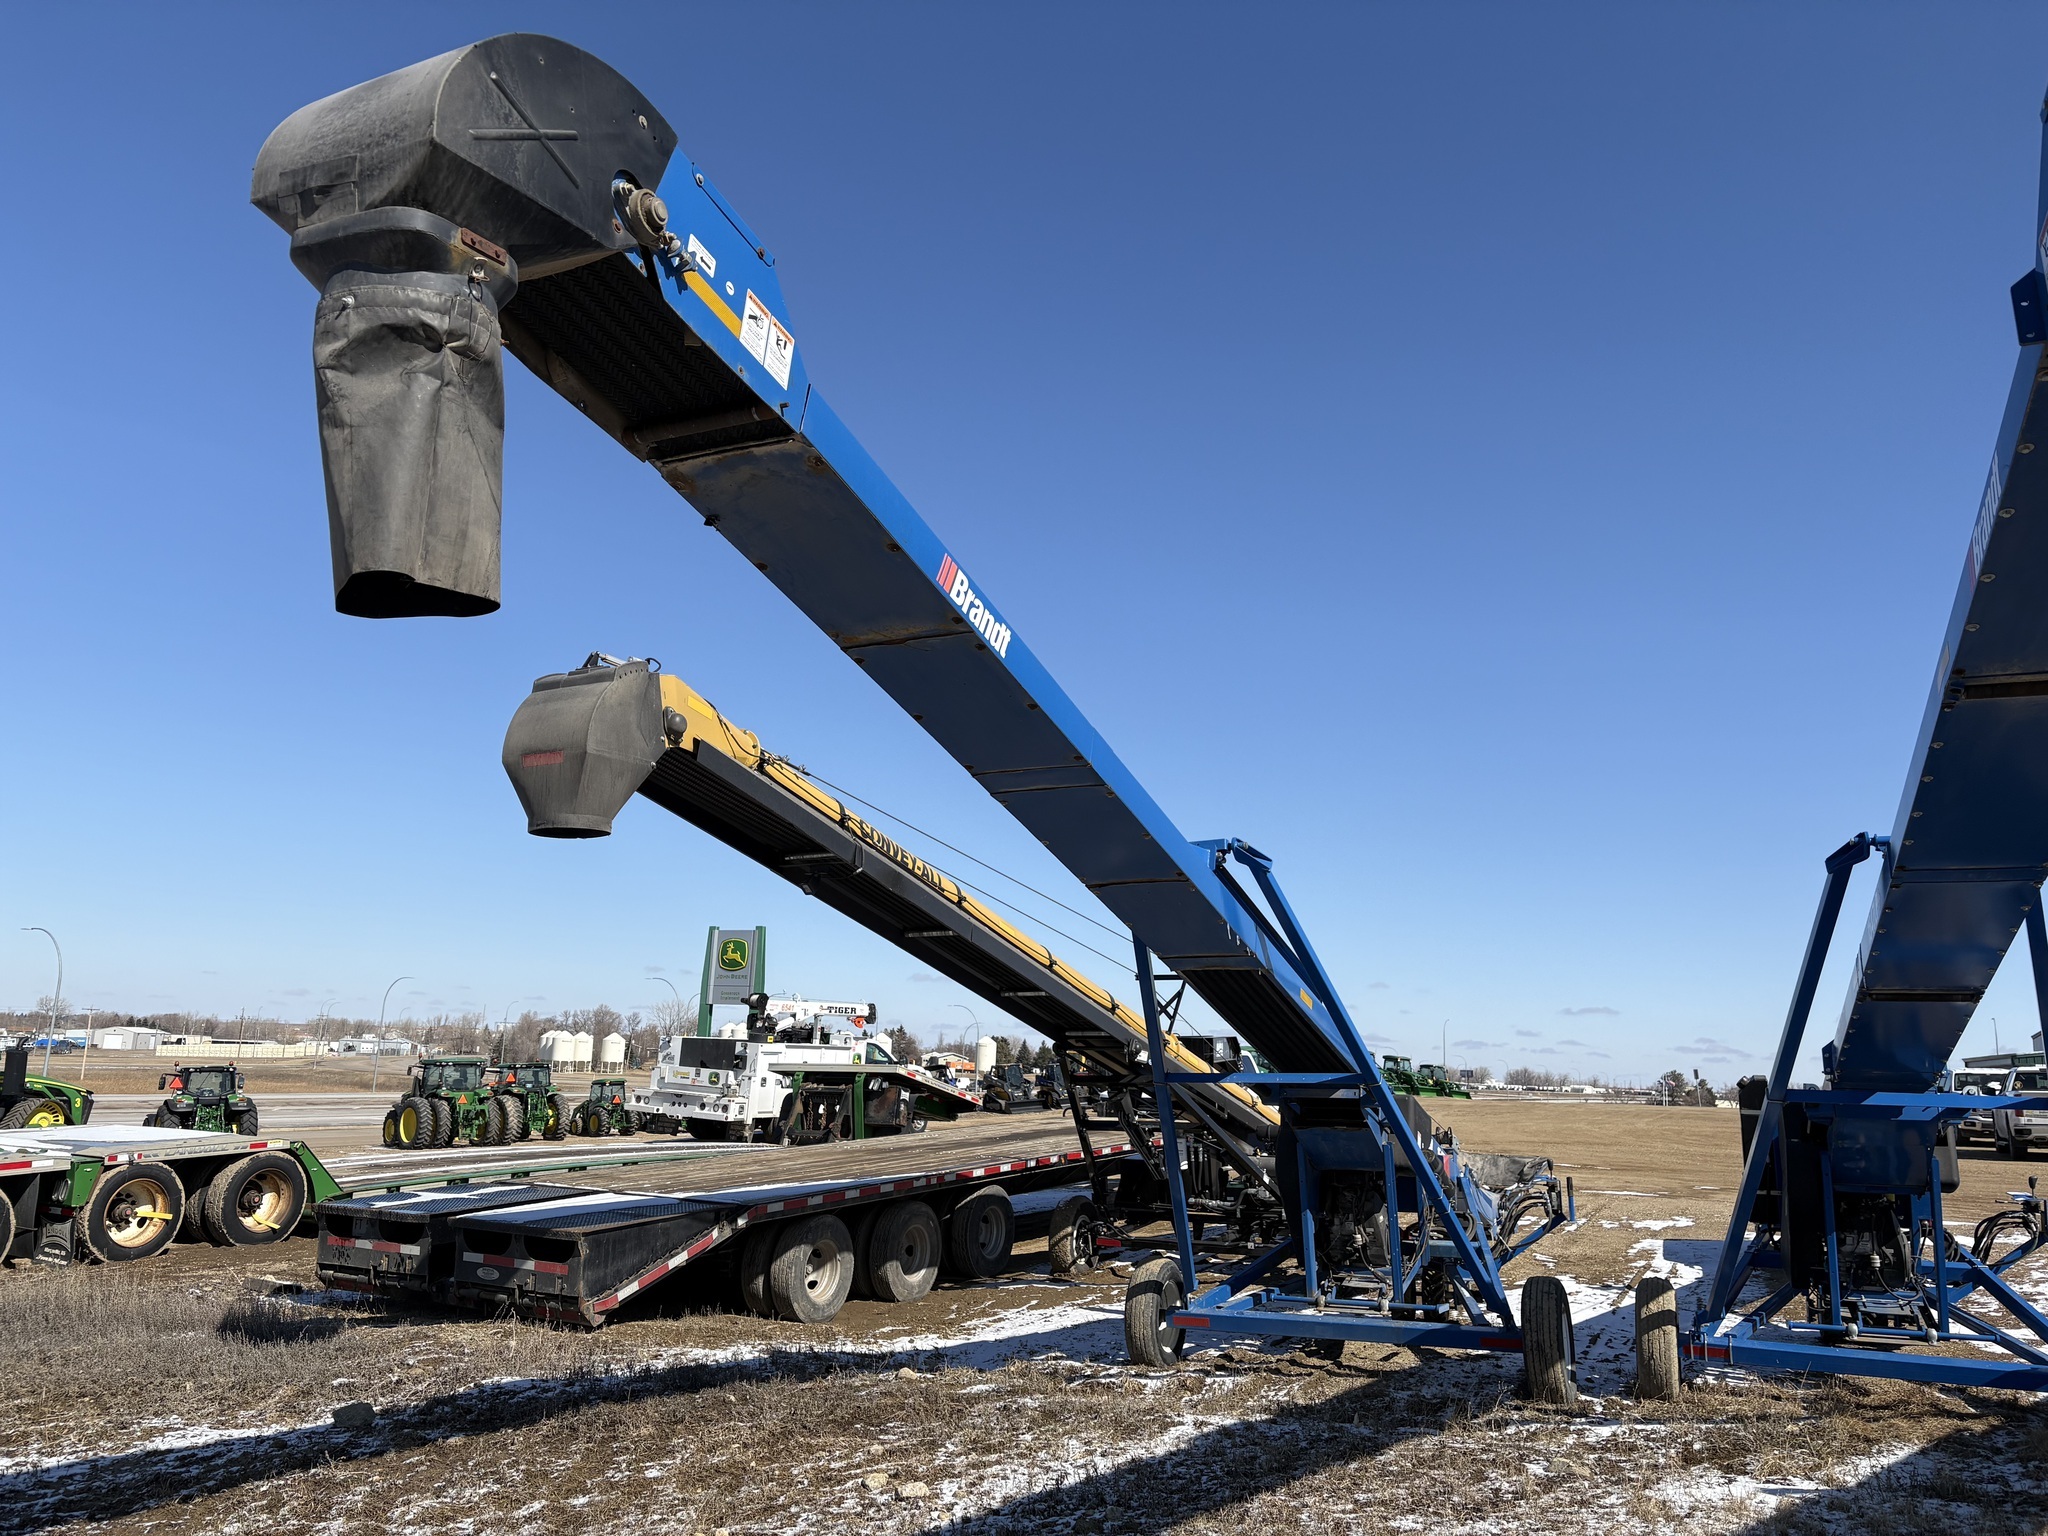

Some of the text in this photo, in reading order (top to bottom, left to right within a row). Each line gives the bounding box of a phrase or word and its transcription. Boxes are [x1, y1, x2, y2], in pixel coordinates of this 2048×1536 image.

[1972, 449, 2002, 581] Brandt
[949, 568, 1012, 659] Brandt
[827, 1006, 857, 1015] TIGER
[74, 1097, 81, 1108] 3
